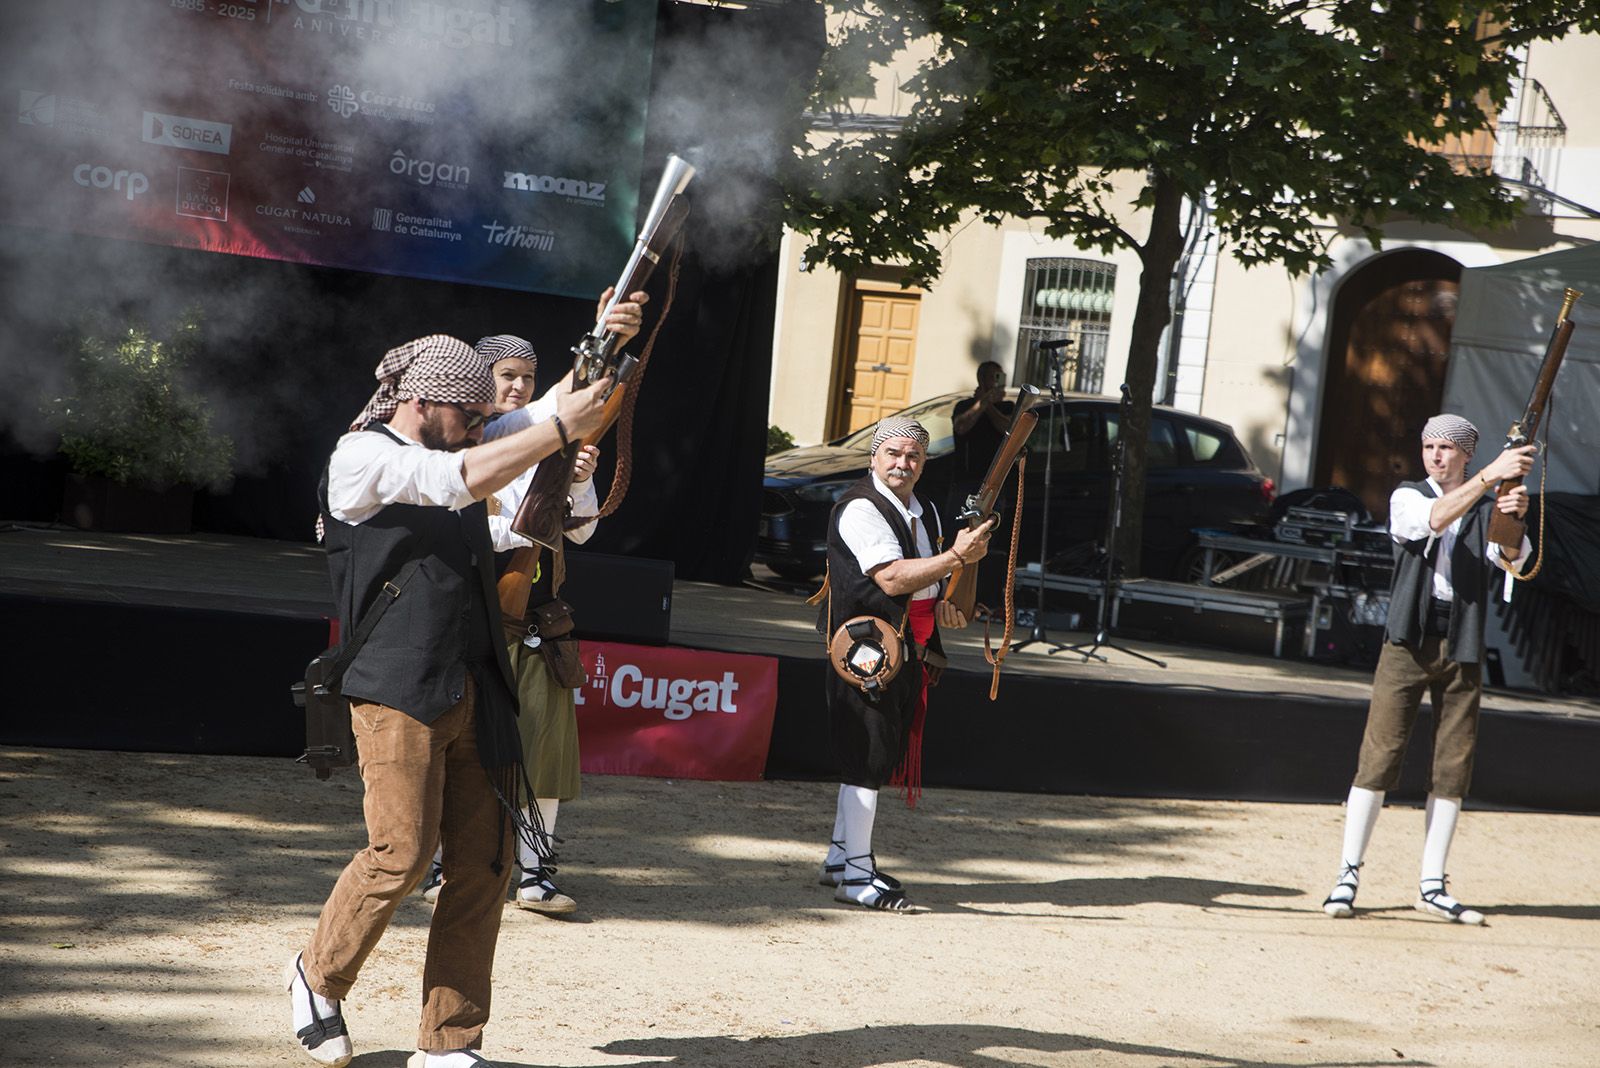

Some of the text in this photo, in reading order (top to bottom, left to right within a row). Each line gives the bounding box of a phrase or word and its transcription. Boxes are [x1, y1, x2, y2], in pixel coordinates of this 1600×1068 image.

[217, 3, 257, 21] 2025
[228, 79, 255, 92] Festa
[295, 89, 318, 103] amb:
[171, 125, 224, 145] SOREA
[265, 132, 303, 146] Hospital
[259, 142, 353, 164] General de Catalunya
[73, 163, 150, 201] corp
[503, 170, 606, 201] moonz
[181, 200, 222, 215] DECOR
[256, 204, 352, 227] CUGAT NATURA
[396, 212, 453, 230] Generalitat
[394, 223, 463, 243] de Catalunya
[611, 664, 740, 721] Cugat
